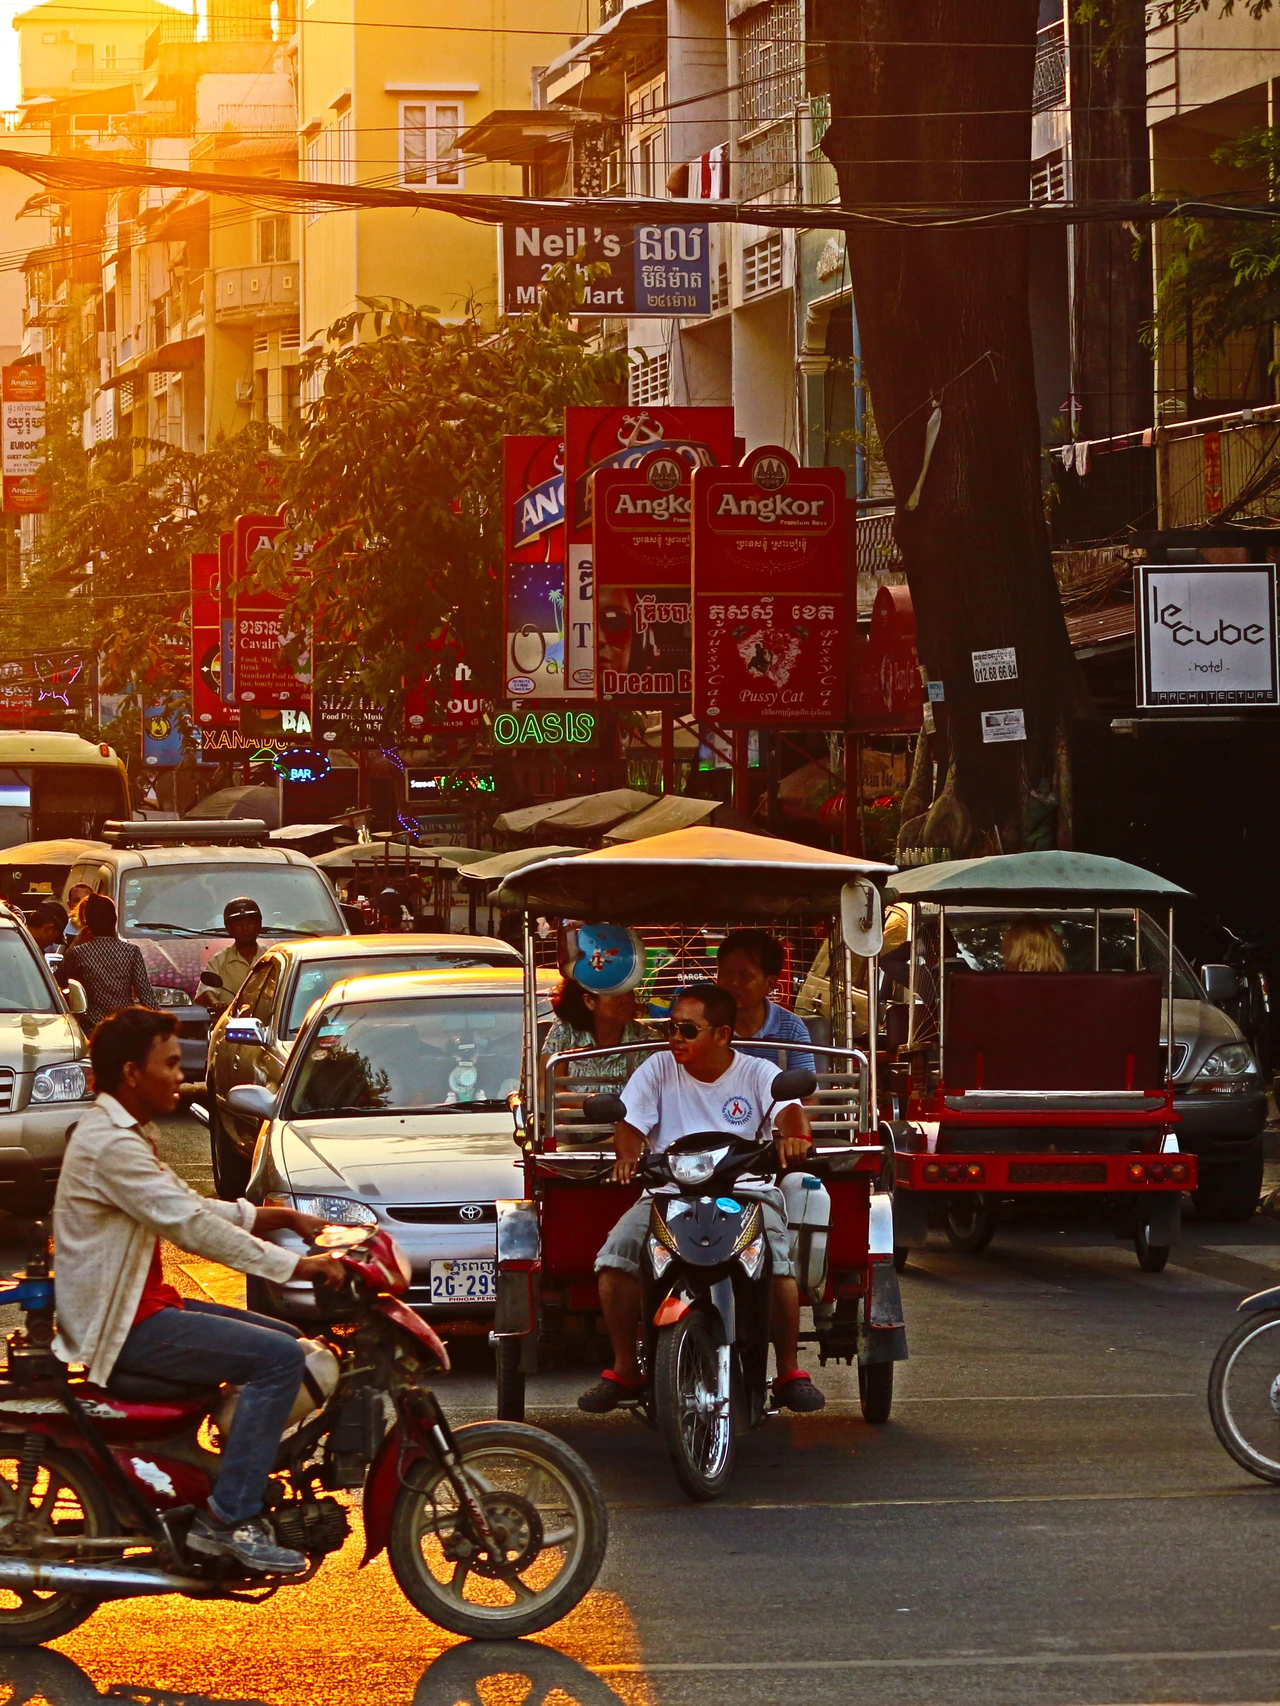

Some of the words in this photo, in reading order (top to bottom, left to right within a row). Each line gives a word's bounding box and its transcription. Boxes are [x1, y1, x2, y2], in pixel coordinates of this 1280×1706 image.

[716, 494, 824, 523] Angkor
[1153, 585, 1182, 629] le
[1173, 618, 1265, 646] cube
[603, 669, 673, 694] Dream
[739, 689, 778, 707] Pussy
[781, 689, 805, 704] Cat
[1160, 691, 1273, 700] ARCHITECTURE
[494, 711, 596, 746] OASIS
[290, 768, 312, 779] BAR
